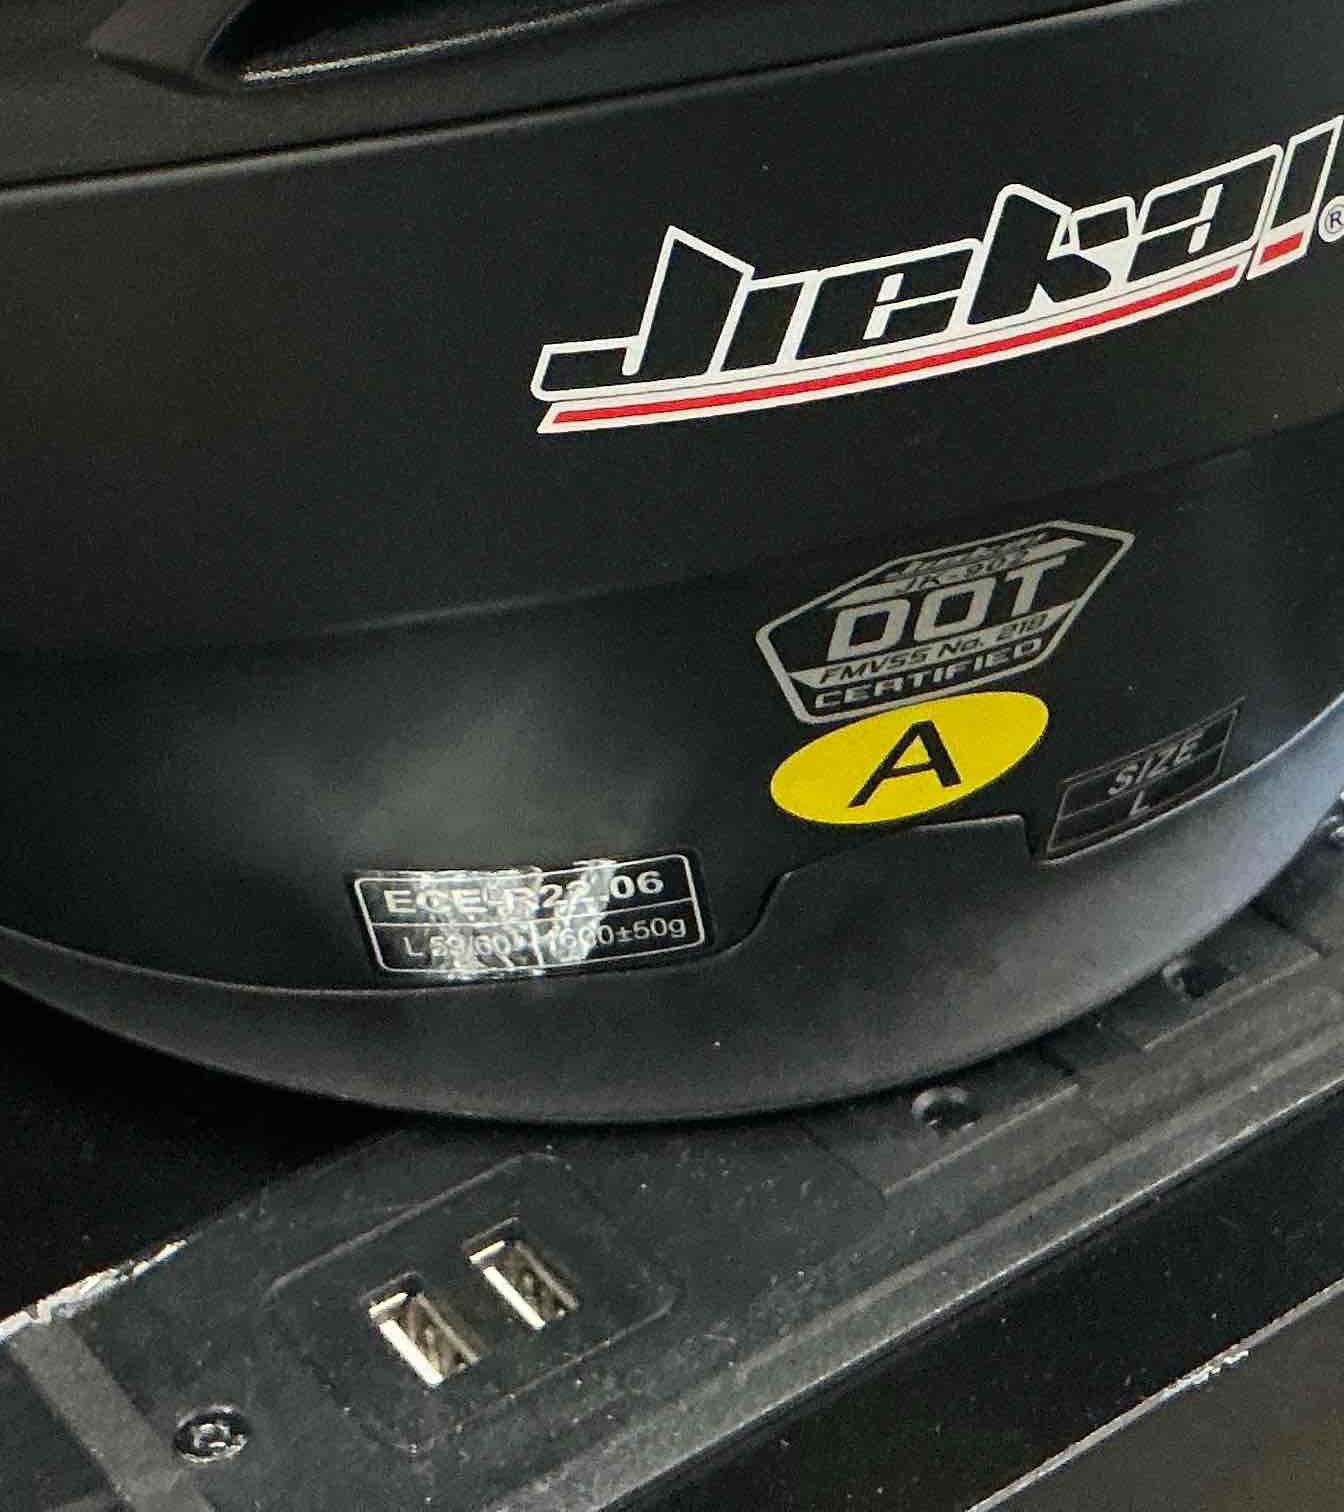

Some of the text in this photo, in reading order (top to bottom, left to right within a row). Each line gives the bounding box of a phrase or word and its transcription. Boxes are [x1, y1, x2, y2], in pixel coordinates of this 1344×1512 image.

[825, 554, 1068, 663] DOT
[813, 636, 1044, 711] CERTIFIED
[818, 612, 1052, 686] FMVSS No. 218
[847, 719, 962, 809] A
[1107, 728, 1206, 796] SIZE
